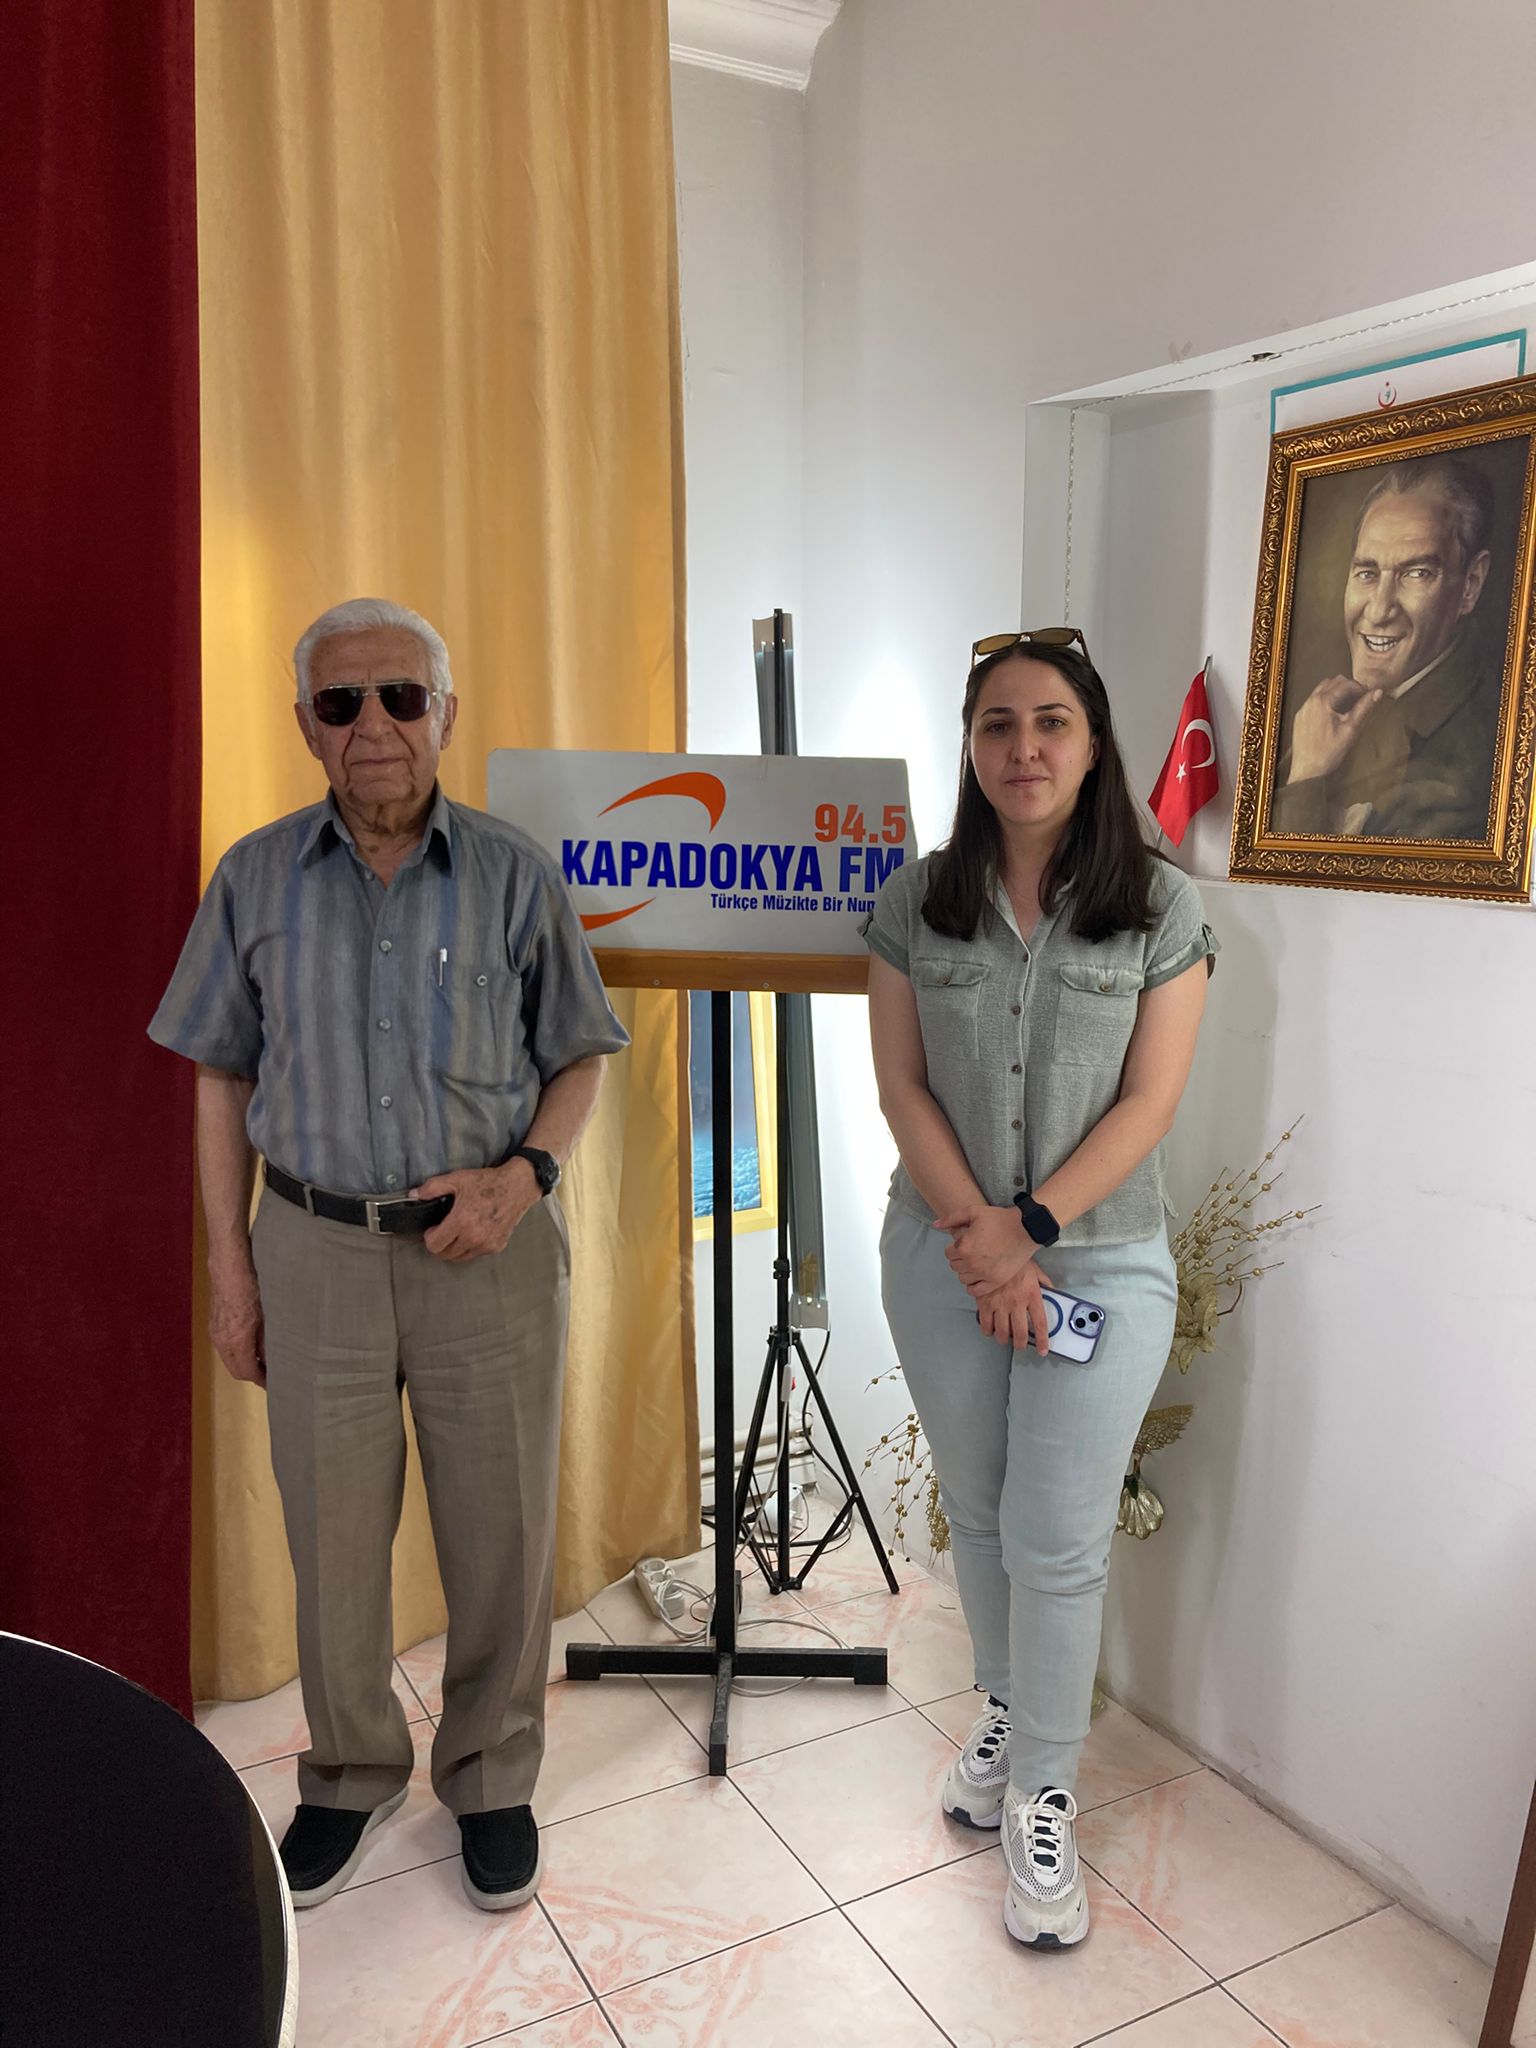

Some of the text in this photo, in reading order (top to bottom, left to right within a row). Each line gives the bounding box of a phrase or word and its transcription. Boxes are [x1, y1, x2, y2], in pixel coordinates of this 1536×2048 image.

[815, 803, 907, 845] 94.5
[562, 839, 904, 893] KAPADOKYA FM
[711, 893, 758, 912] Türkçe
[763, 895, 818, 911] Müzikte
[823, 896, 843, 912] Bir
